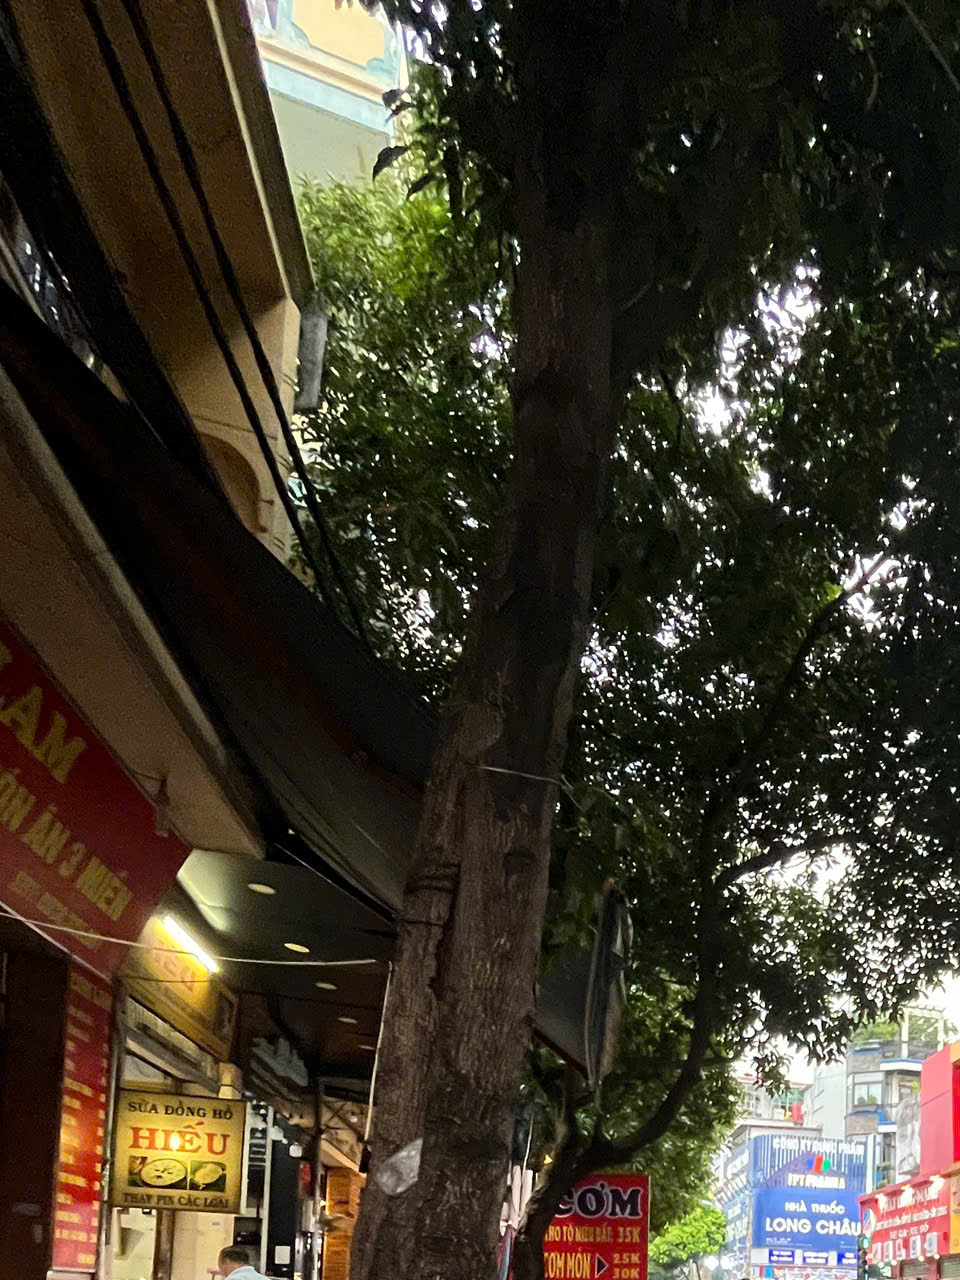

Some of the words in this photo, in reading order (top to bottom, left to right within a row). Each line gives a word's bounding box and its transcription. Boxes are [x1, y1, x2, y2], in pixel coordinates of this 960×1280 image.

[128, 1098, 159, 1114] SỬA
[164, 1101, 207, 1118] ĐỒNG
[212, 1104, 233, 1120] HỒ
[128, 1121, 231, 1155] HIẾU
[784, 1199, 807, 1213] NHÀ
[811, 1200, 845, 1215] THUỐC
[765, 1217, 812, 1233] LONG
[815, 1217, 862, 1236] CHÂU
[566, 1247, 591, 1279] MÓN
[613, 1268, 640, 1279] 30K
